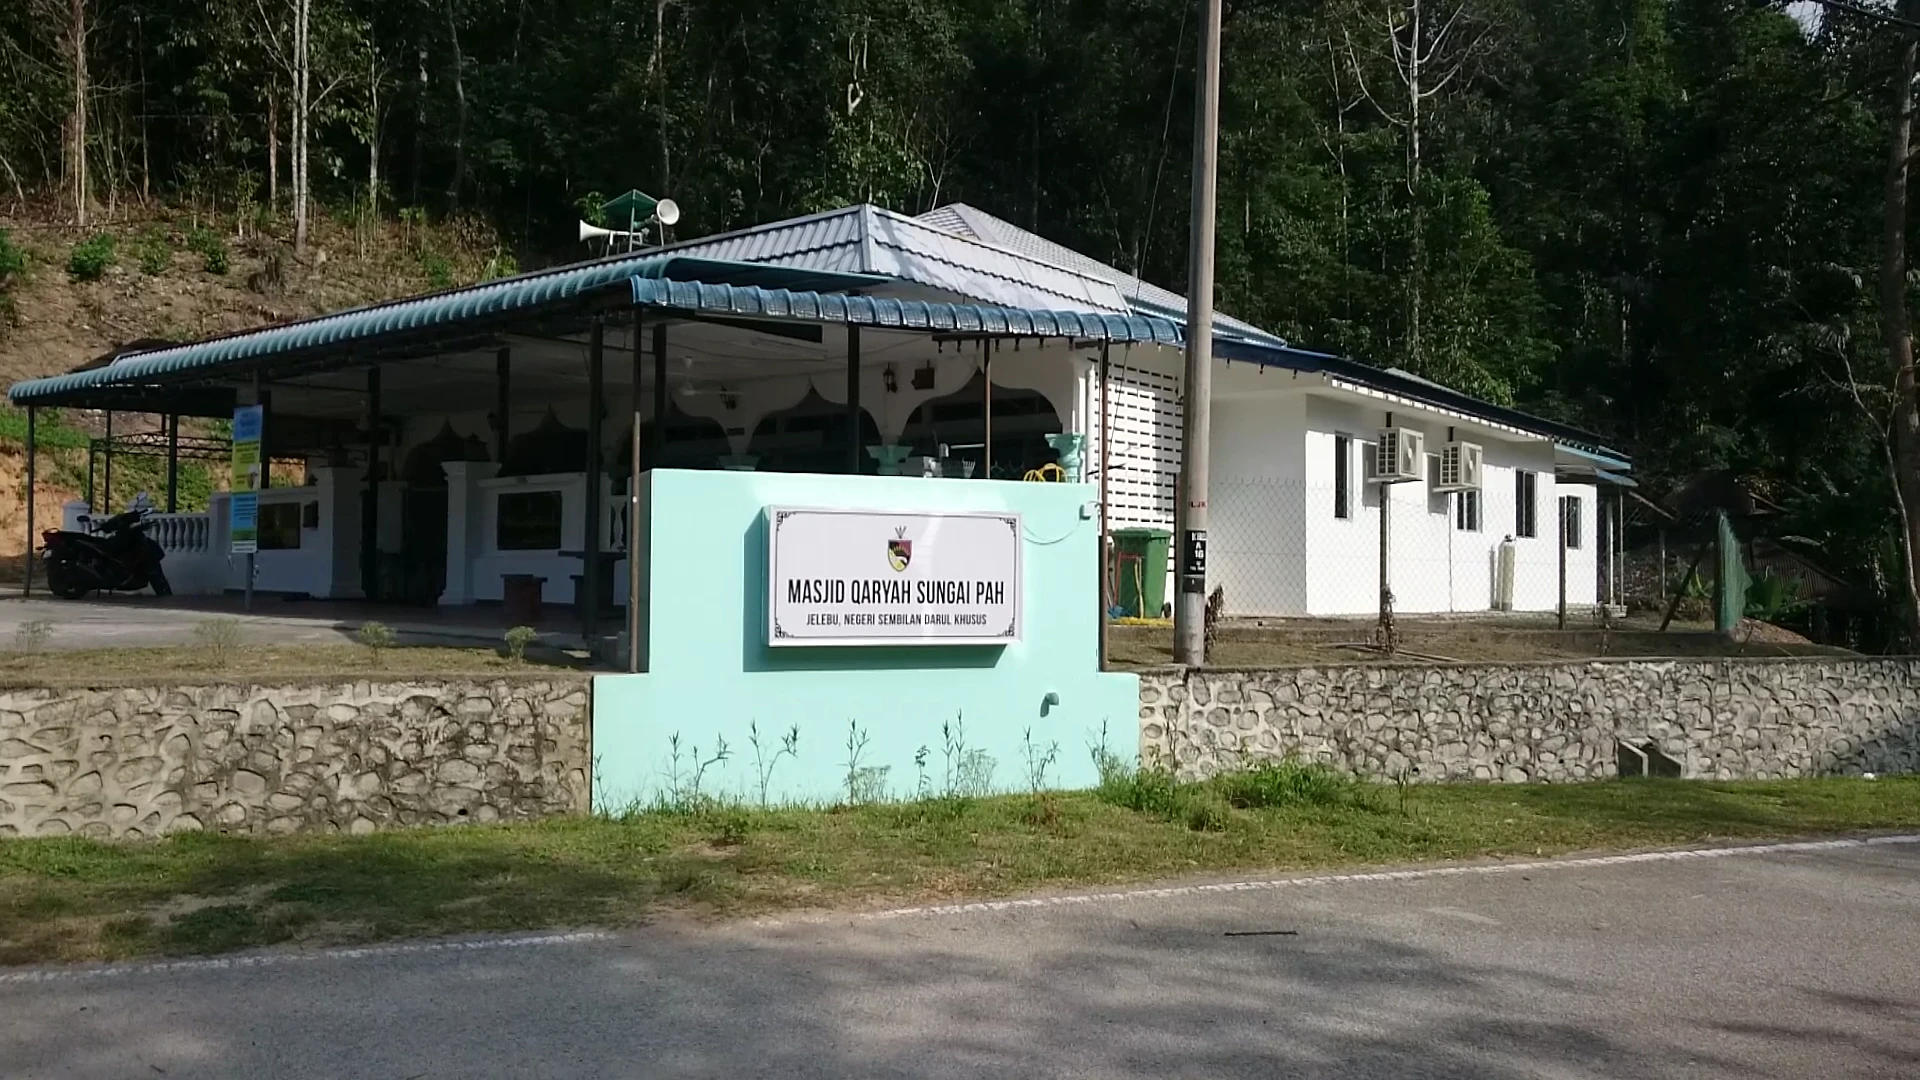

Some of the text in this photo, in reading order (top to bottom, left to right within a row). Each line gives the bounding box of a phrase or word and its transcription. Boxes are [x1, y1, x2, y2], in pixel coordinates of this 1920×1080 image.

[787, 579, 1004, 605] MASJID QARYAH SUNGAI PAH
[806, 613, 987, 627] JELEBU, NEGERI SEMBILAN DARUL KHUSUS
